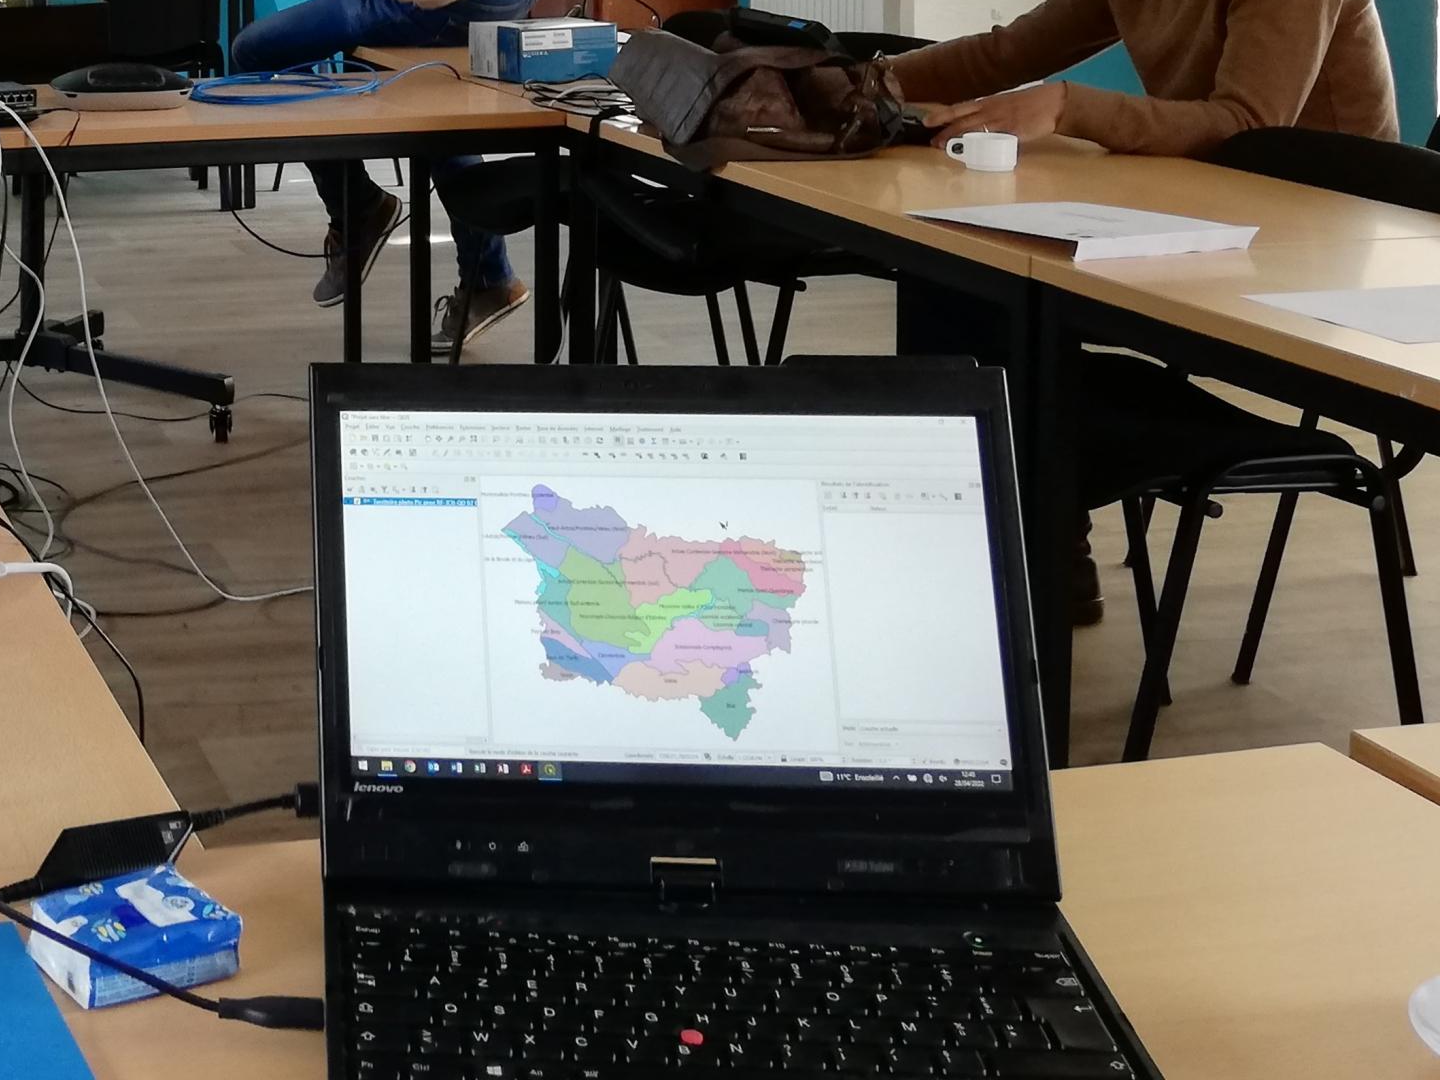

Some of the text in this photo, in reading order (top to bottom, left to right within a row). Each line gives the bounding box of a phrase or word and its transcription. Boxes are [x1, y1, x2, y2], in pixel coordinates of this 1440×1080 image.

[354, 781, 404, 793] lenovo
[430, 976, 440, 986] A
[478, 978, 489, 988] Z
[625, 983, 636, 992] T
[675, 985, 687, 996] Y
[724, 987, 737, 998] U
[826, 992, 840, 1002] O
[494, 1005, 506, 1015] S
[544, 1007, 556, 1017] D
[697, 1014, 710, 1024] H
[797, 1018, 811, 1028] K
[849, 1019, 861, 1030] L
[900, 1022, 918, 1032] M
[472, 1031, 489, 1042] W
[524, 1034, 536, 1045] X
[576, 1037, 588, 1047] C
[626, 1038, 639, 1049] V
[729, 1042, 744, 1054] N
